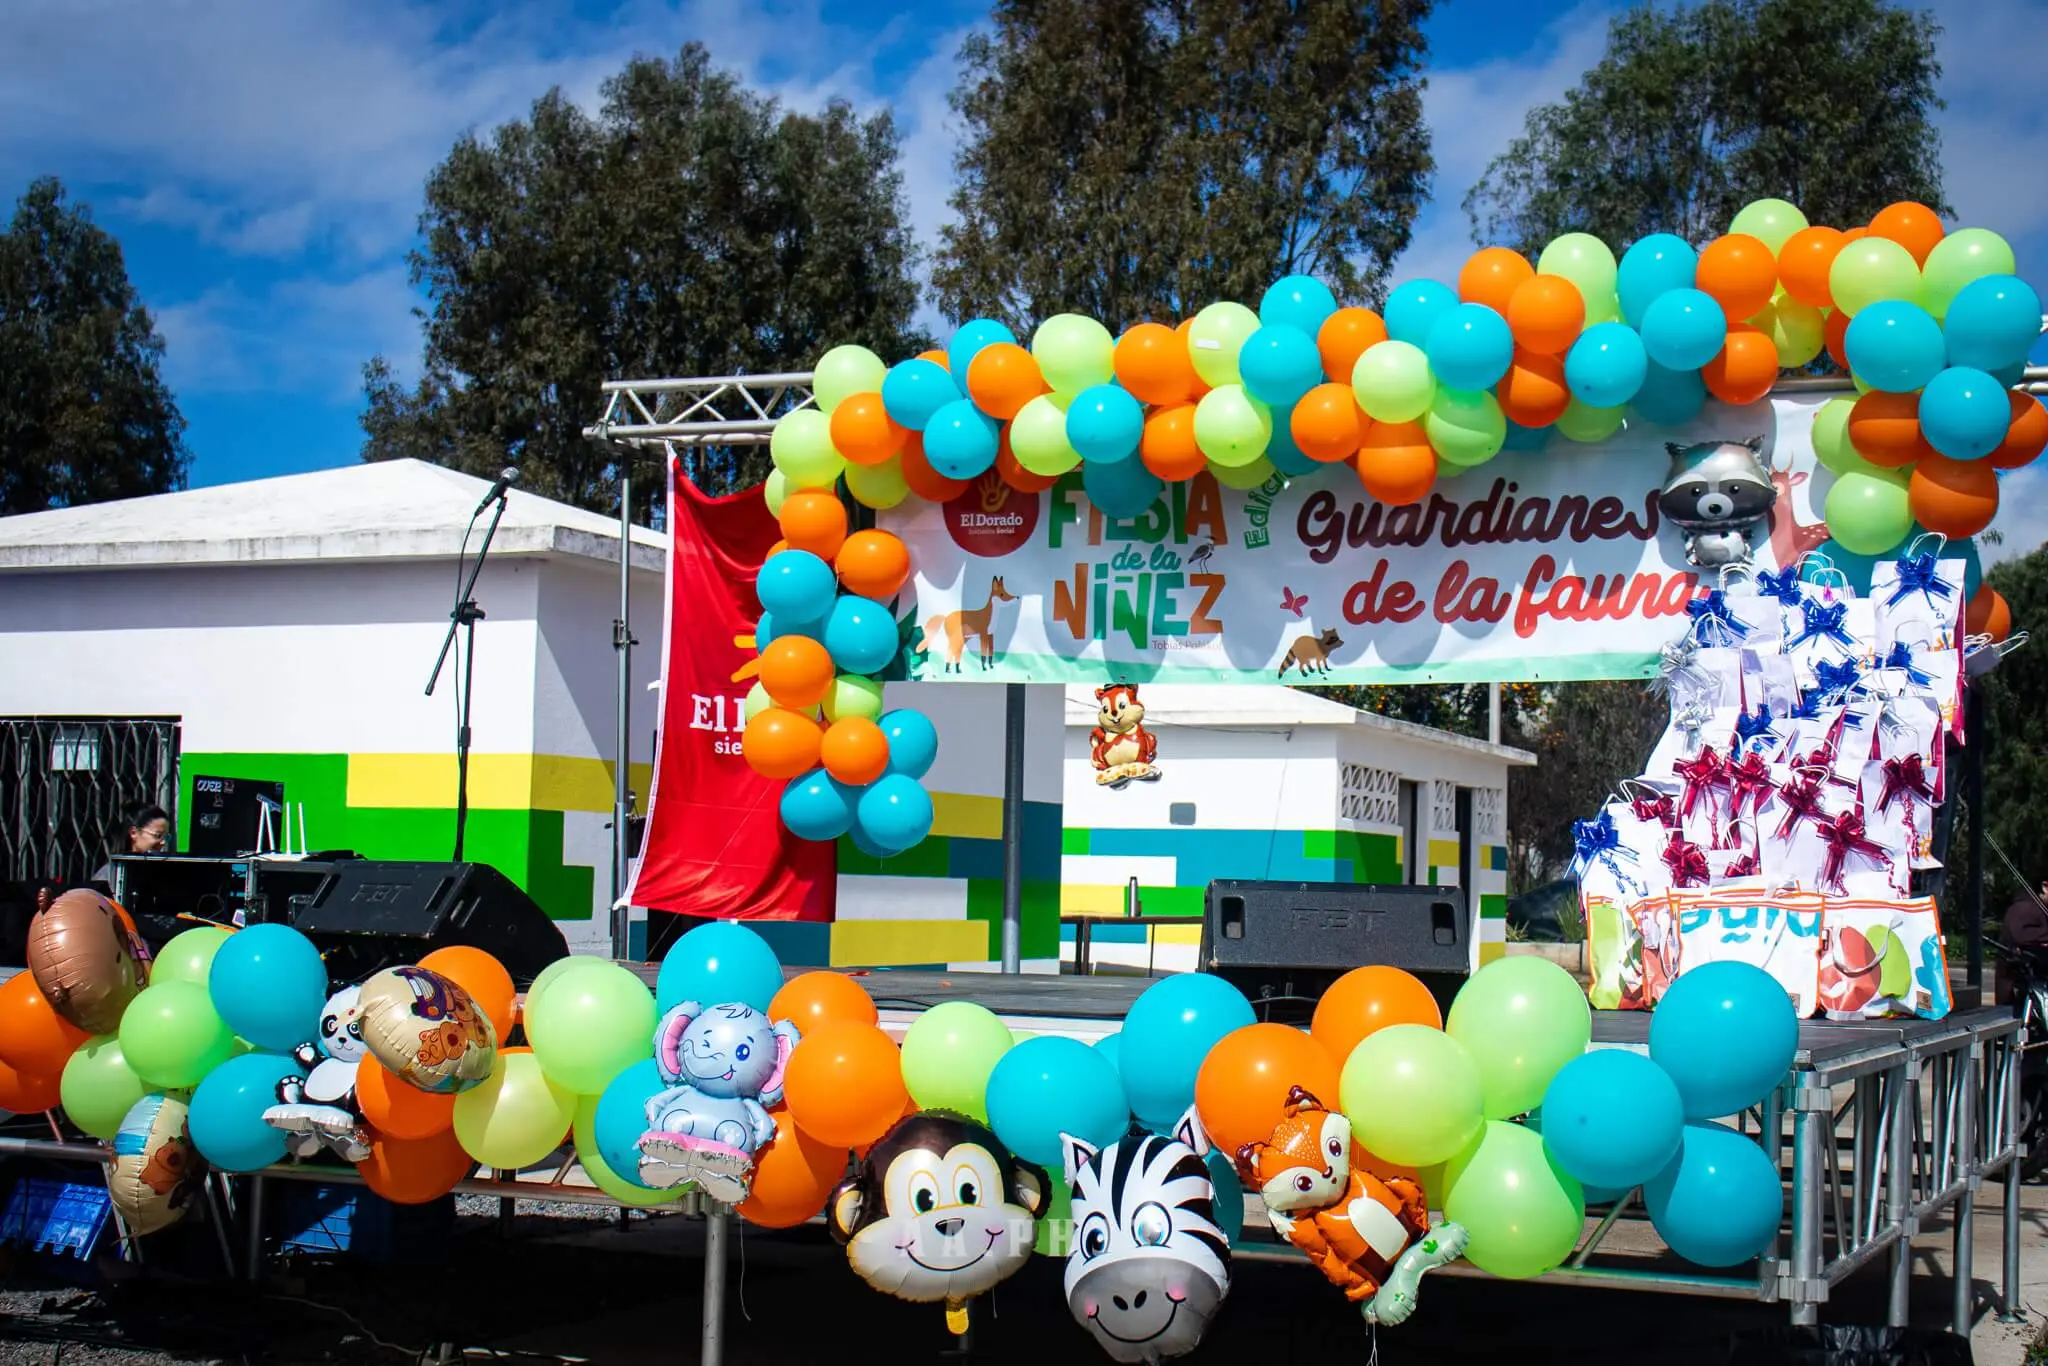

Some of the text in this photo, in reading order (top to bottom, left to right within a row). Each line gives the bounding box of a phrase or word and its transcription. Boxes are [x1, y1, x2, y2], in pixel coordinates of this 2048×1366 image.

[960, 512, 1023, 527] El Dorado
[1297, 477, 1661, 563] Guardianes
[1111, 543, 1182, 571] de la
[1342, 554, 1712, 639] de la fauna
[689, 693, 728, 733] El
[714, 735, 743, 756] sie
